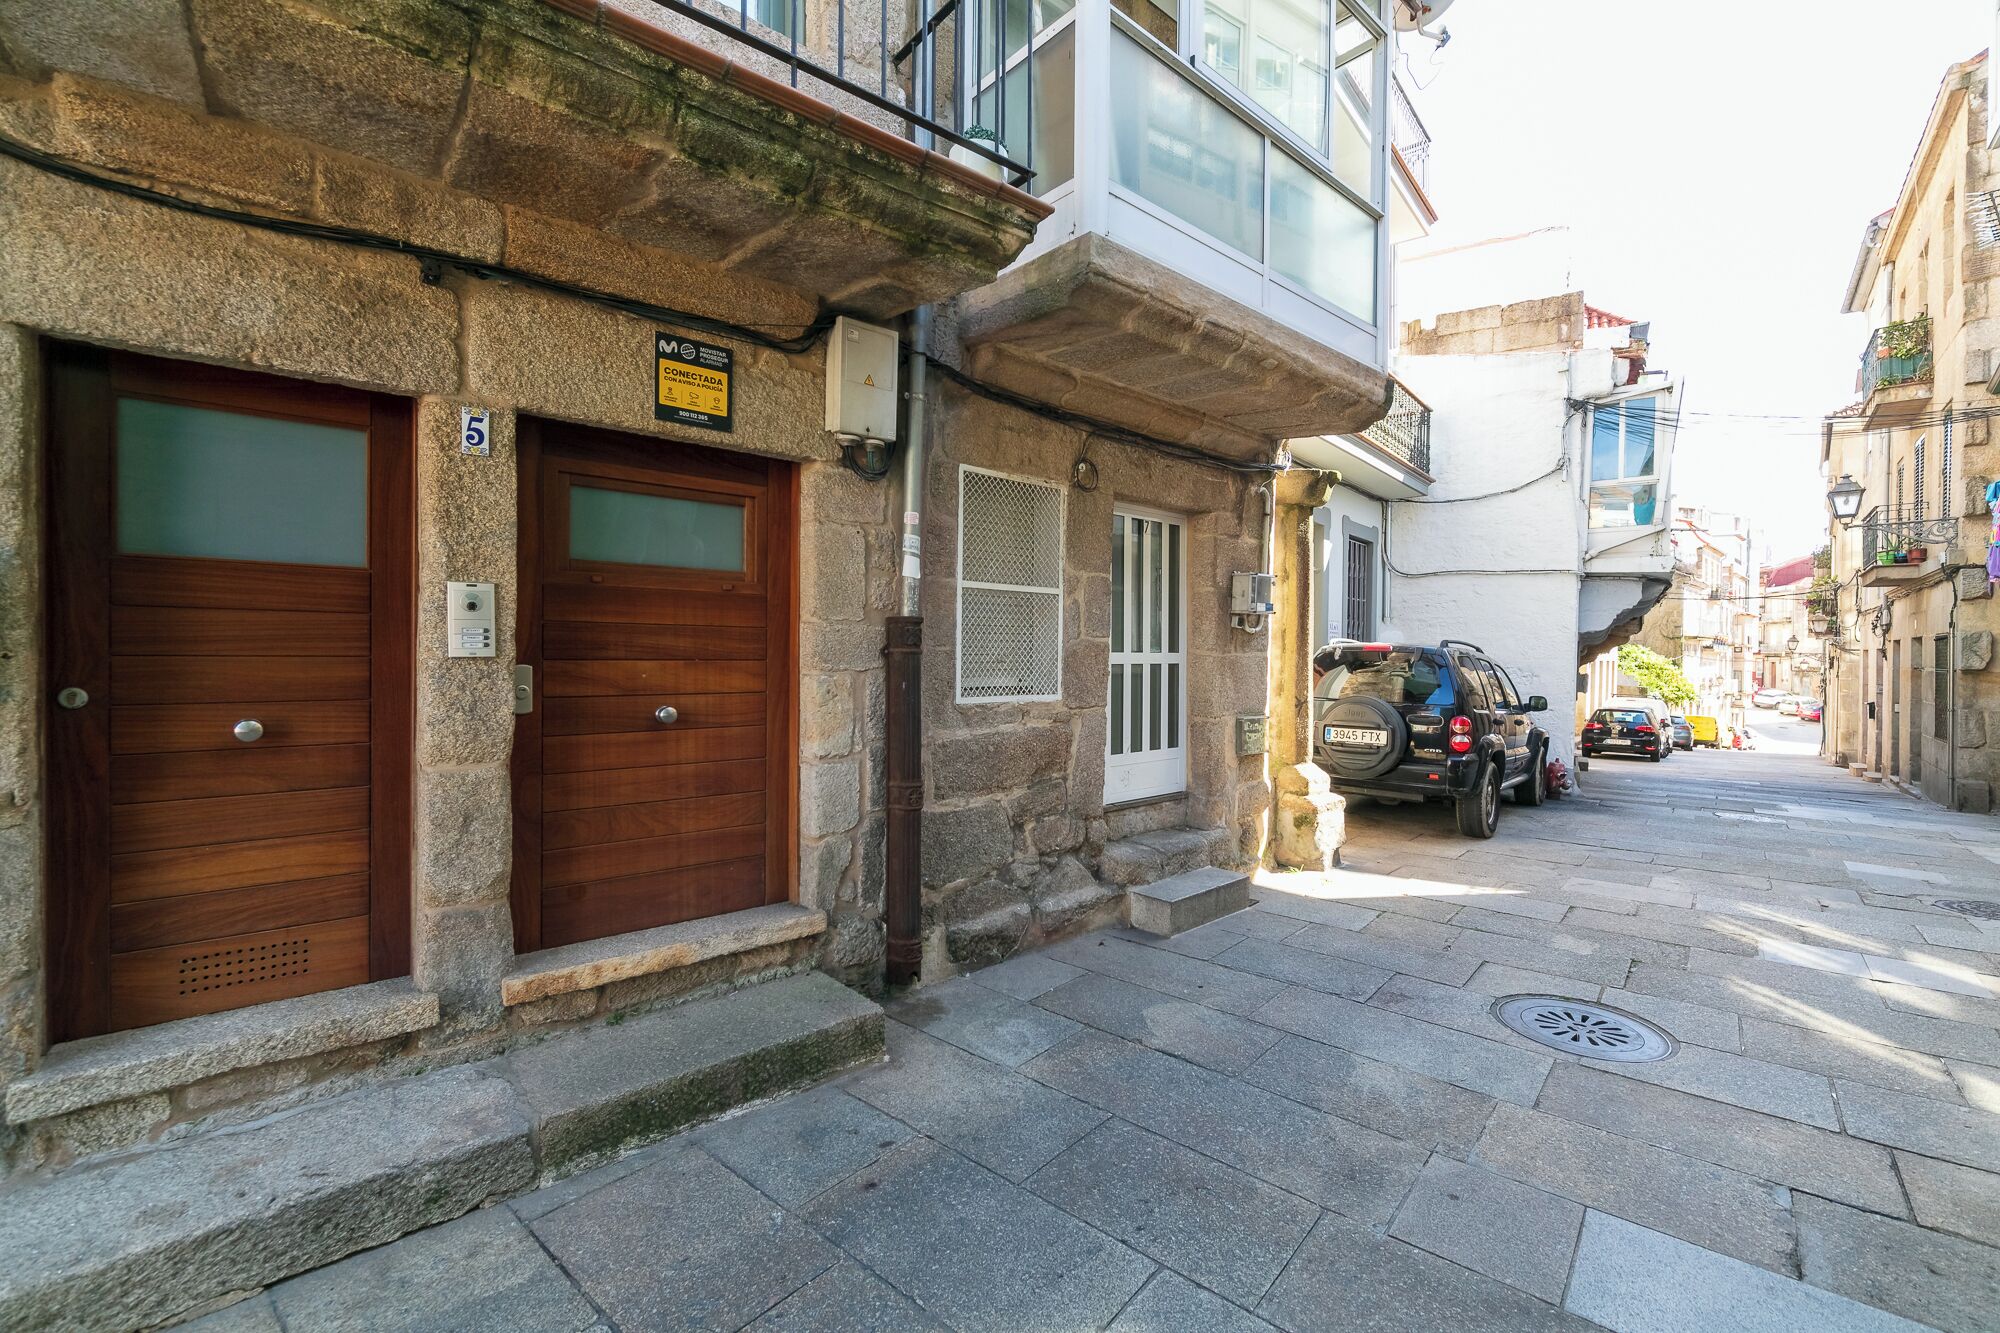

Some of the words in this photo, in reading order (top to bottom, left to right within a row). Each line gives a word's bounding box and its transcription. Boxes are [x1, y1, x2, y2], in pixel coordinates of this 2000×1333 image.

[699, 347, 727, 358] MOVISTAR
[699, 353, 729, 364] PROSEGUR
[699, 358, 723, 367] ALARMAS
[664, 366, 724, 386] CONECTADA
[664, 375, 677, 383] CON
[678, 379, 696, 387] AVISO
[702, 384, 724, 393] POLICÍA
[465, 416, 485, 447] 5
[1145, 520, 1149, 534] 7
[1344, 708, 1366, 719] Jeep
[1332, 729, 1358, 741] 3945
[1361, 731, 1381, 743] FTX
